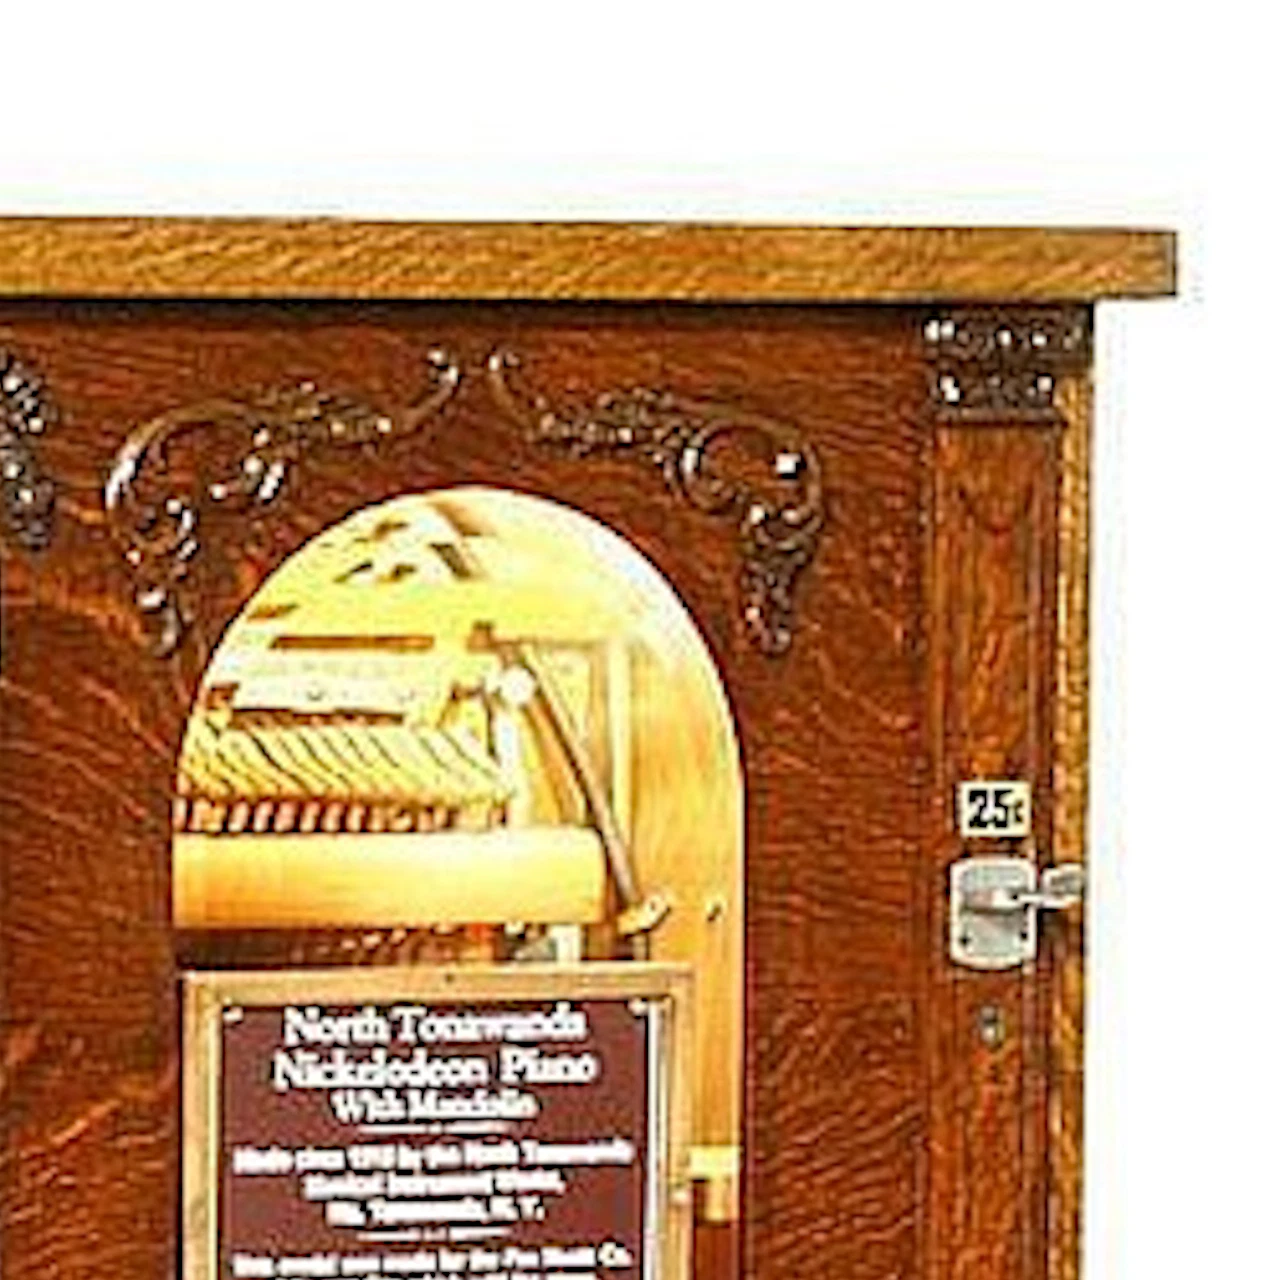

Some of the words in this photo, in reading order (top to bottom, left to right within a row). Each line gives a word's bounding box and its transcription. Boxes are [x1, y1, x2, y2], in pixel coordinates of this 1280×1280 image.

[285, 1008, 390, 1046] North
[275, 1049, 488, 1089] Nickelodeon
[501, 1047, 596, 1083] Piano
